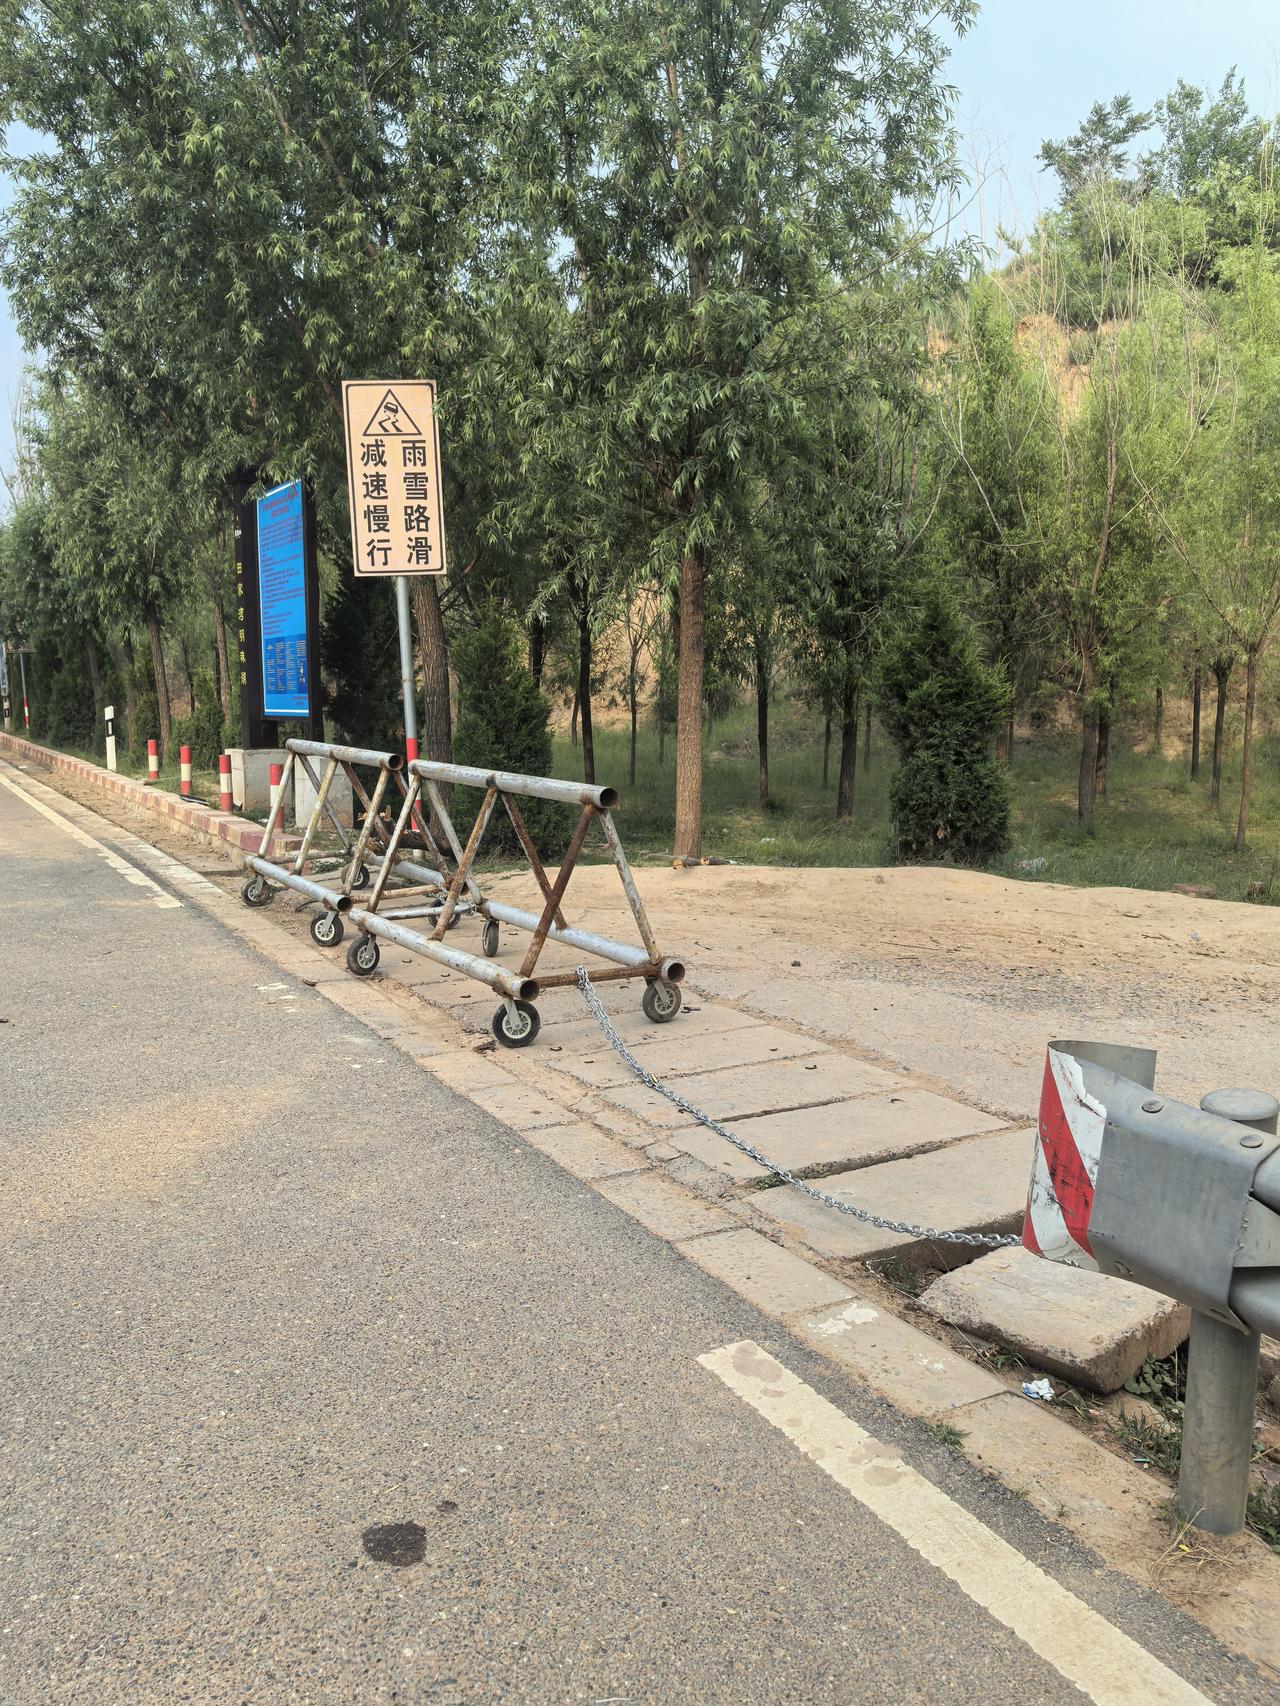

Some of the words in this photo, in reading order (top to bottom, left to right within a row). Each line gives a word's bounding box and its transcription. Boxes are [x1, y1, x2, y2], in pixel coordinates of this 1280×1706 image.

[360, 438, 392, 567] 减速慢行
[401, 439, 432, 566] 雨雪路滑
